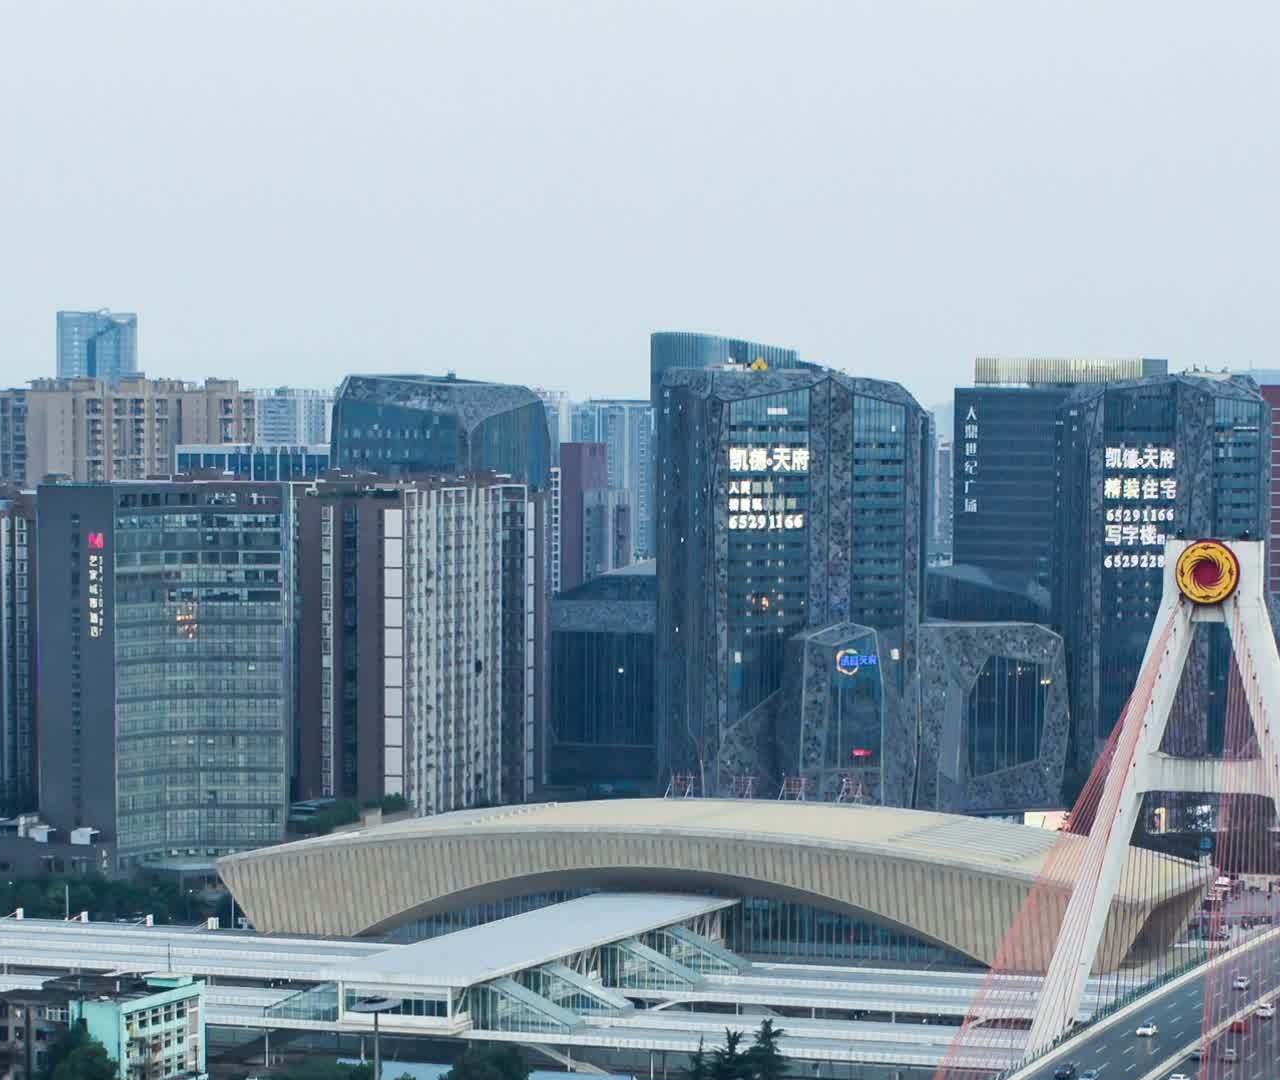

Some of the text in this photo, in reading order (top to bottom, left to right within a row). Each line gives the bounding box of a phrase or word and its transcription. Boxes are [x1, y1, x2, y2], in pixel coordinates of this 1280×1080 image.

[1104, 478, 1176, 499] 精装住宅
[728, 514, 804, 529] 65291166
[1106, 508, 1174, 522] 65291166
